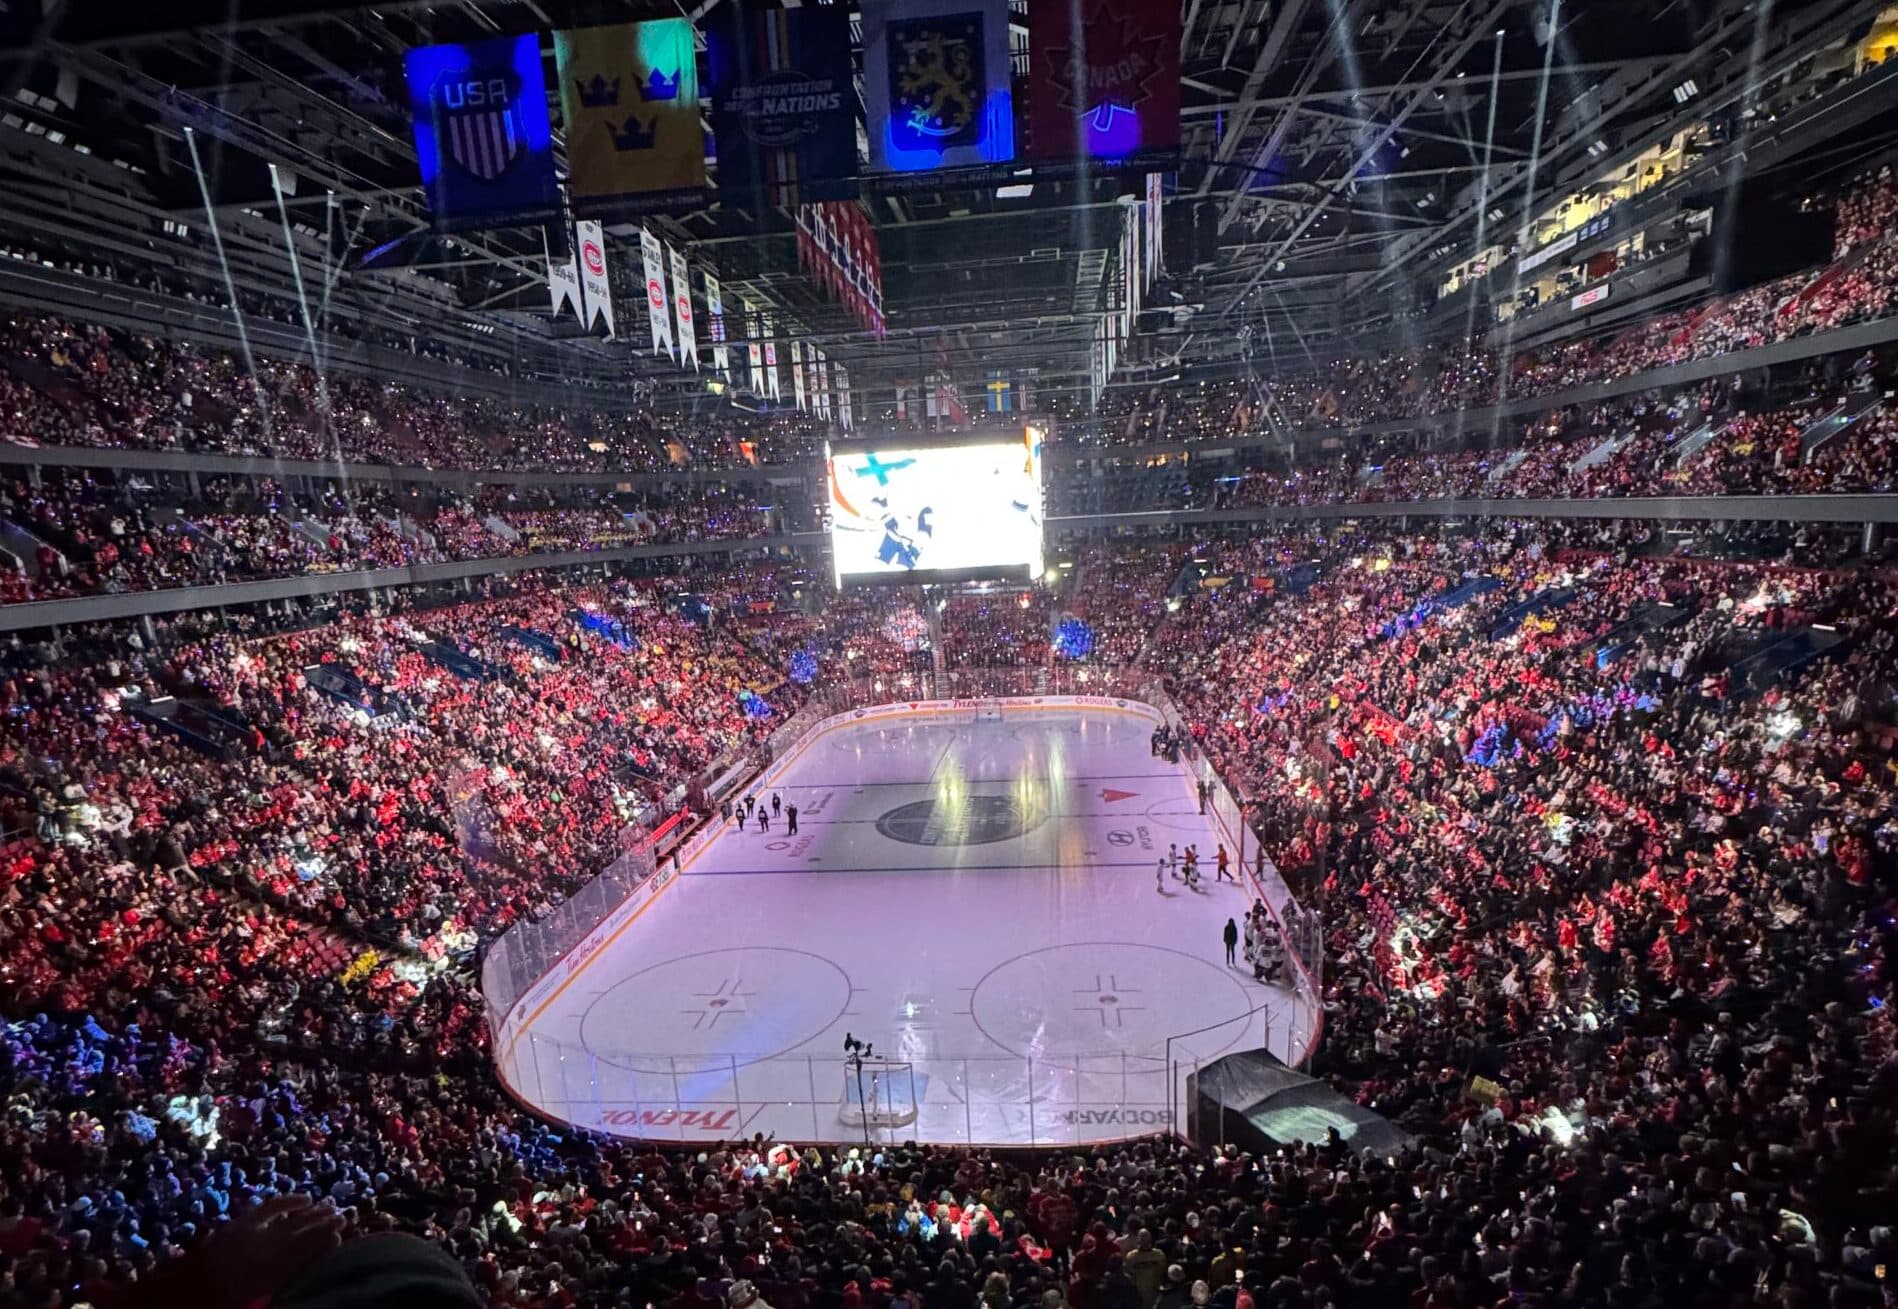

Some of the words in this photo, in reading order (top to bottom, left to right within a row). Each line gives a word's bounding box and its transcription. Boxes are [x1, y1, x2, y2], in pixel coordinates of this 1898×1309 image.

[444, 78, 509, 108] USA
[761, 92, 841, 114] NATIONS
[601, 1109, 738, 1131] TYLENOL
